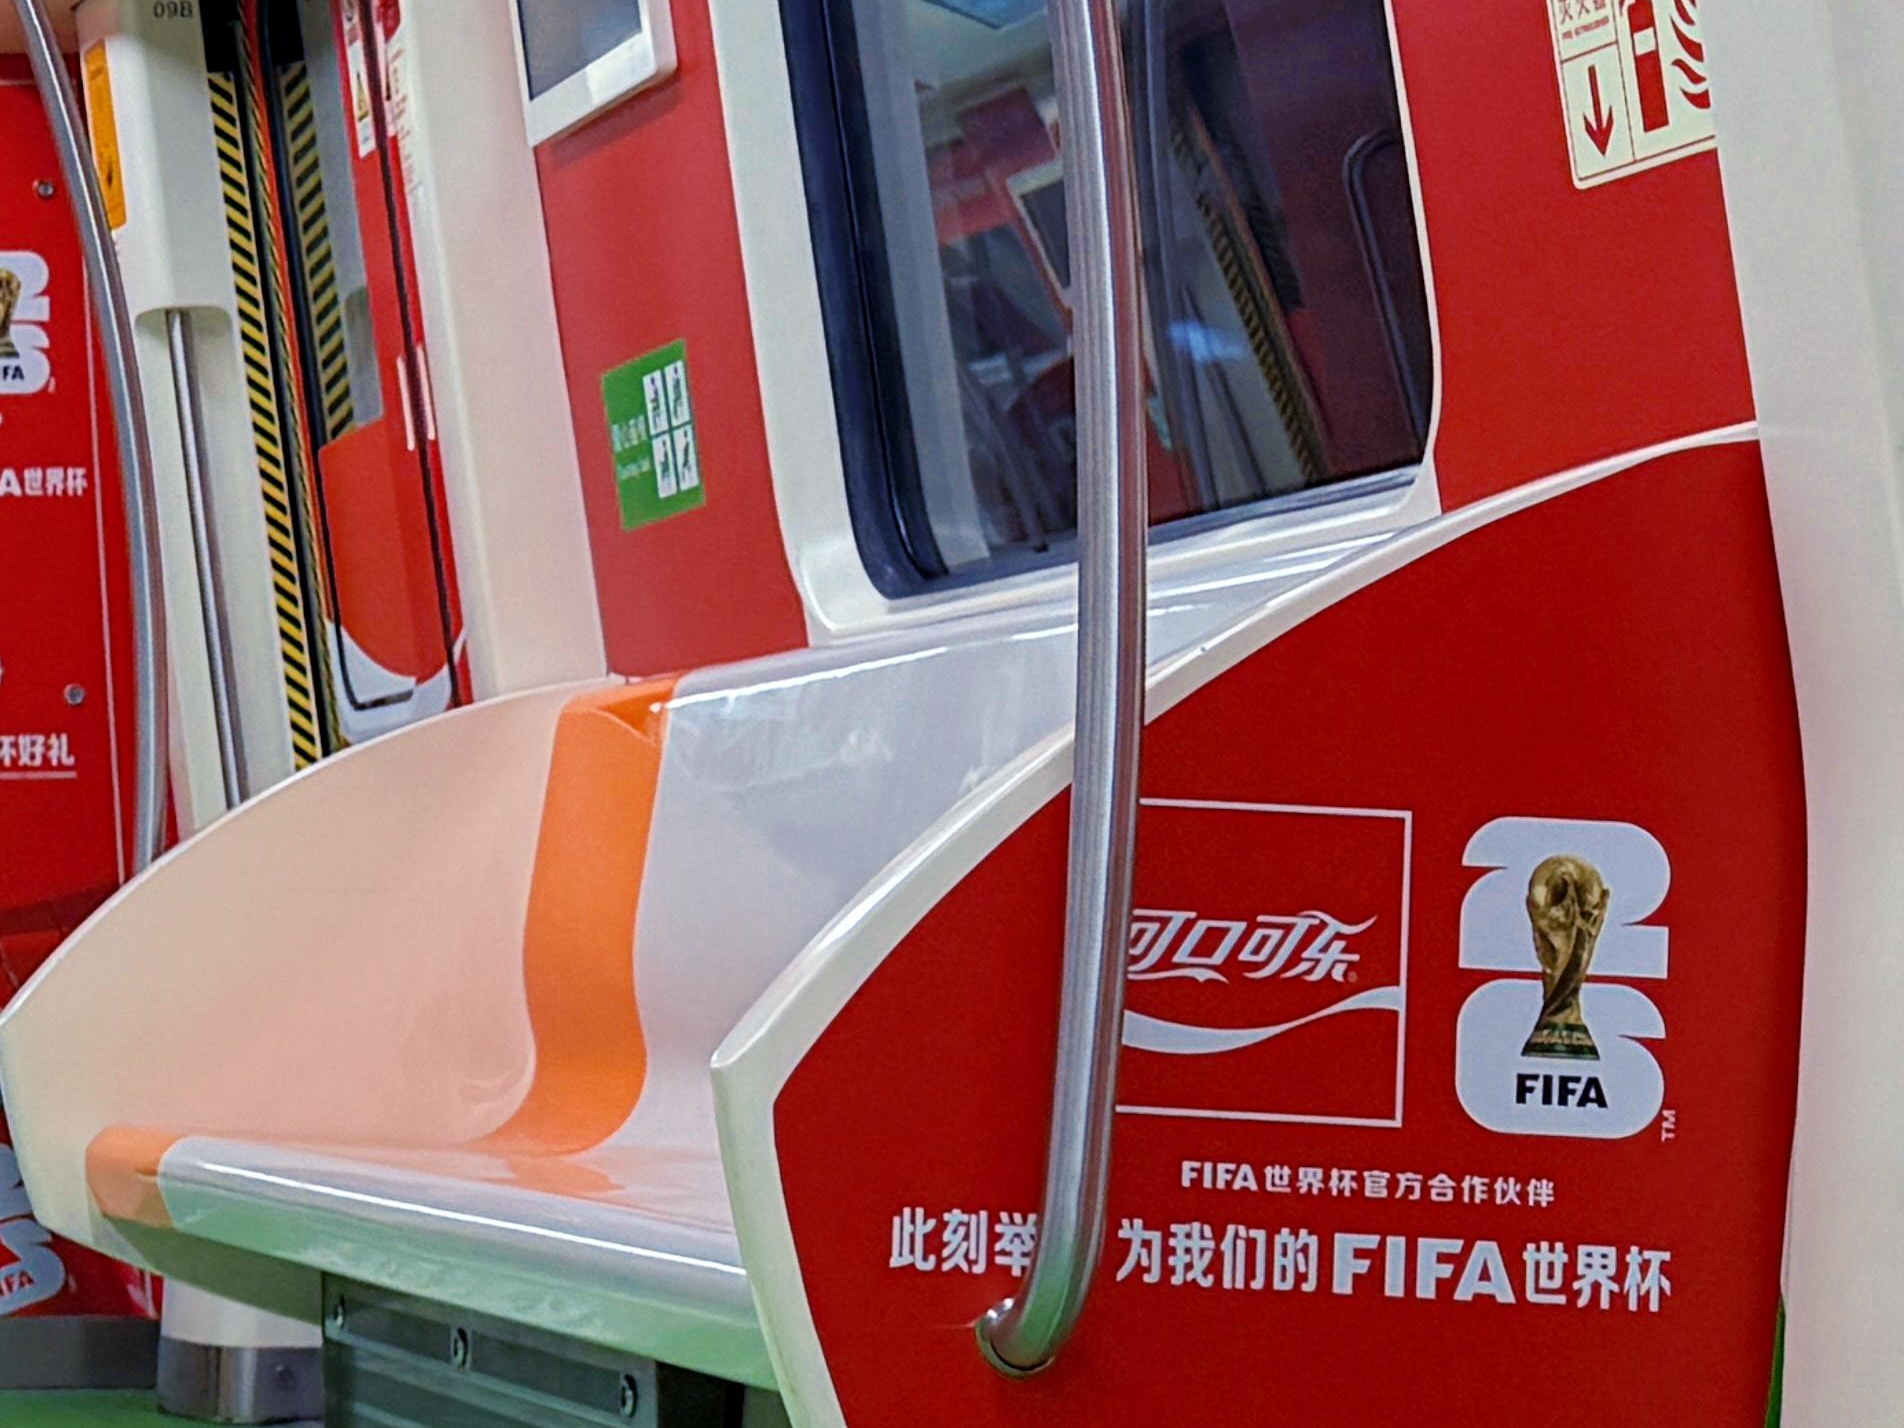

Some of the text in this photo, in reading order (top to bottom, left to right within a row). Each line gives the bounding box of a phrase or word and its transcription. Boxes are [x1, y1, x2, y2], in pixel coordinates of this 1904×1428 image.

[1514, 1072, 1609, 1110] FIFA
[1180, 1160, 1555, 1210] FIFA世界杯官方合作伙伴
[888, 1207, 1673, 1314] 此刻举 为我们的FIFA世界杯
